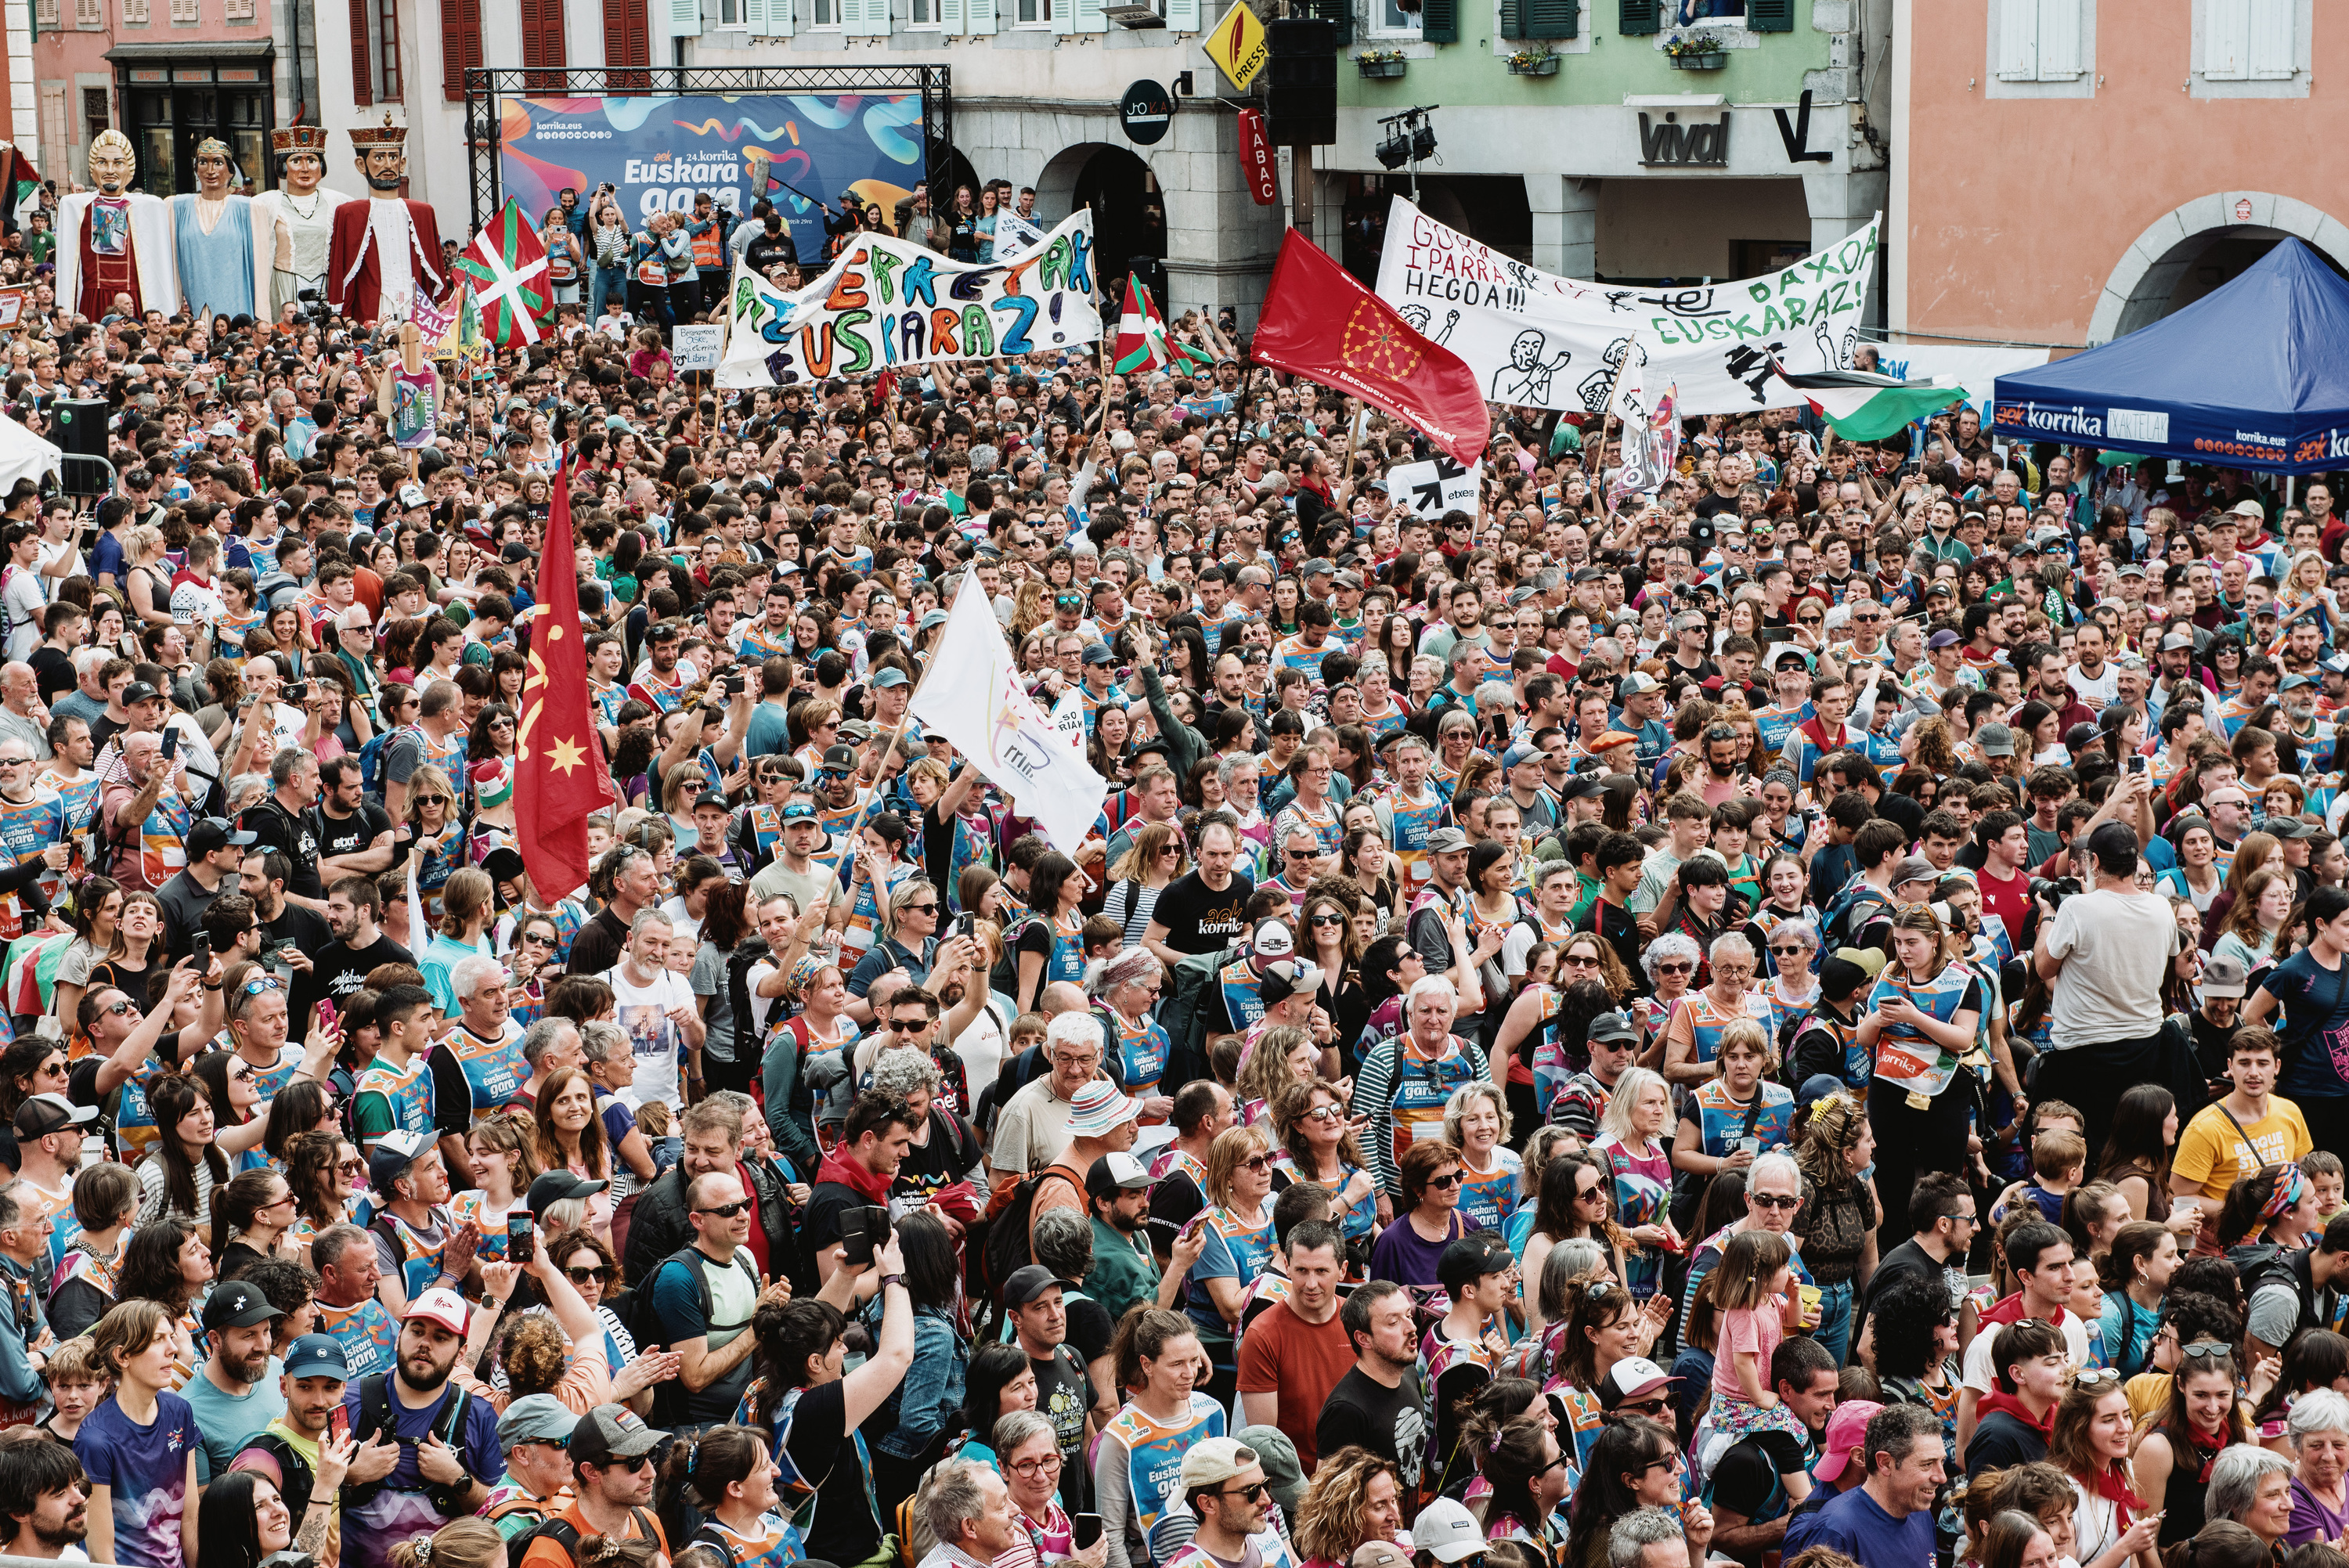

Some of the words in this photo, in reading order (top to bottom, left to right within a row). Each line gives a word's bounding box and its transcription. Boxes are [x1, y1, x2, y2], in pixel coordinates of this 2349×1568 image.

[536, 121, 583, 131] korrika.eus
[1637, 111, 1730, 163] vival
[654, 150, 672, 161] aek
[687, 149, 738, 162] 24.korrika
[1249, 115, 1273, 199] TABAC
[624, 157, 739, 184] Euskara
[1413, 215, 1496, 264] GORA
[1405, 245, 1507, 286] IPARRA
[1651, 280, 1862, 344] EUSKARAZ!
[1339, 371, 1396, 406] Recuperar
[422, 383, 434, 431] korrika
[1995, 401, 2024, 427] aek
[2026, 401, 2103, 438] korrika
[2107, 409, 2168, 442] TXARTELAK
[2235, 428, 2287, 447] korrika.eus
[2294, 432, 2329, 463] aek
[1763, 727, 1791, 737] Euskara
[2, 827, 38, 840] Euskara
[1405, 827, 1429, 835] Euskara
[9, 834, 39, 849] gara
[425, 870, 449, 884] gara
[1199, 917, 1243, 935] korrika
[1133, 1053, 1158, 1067] Euskara
[1882, 1051, 1917, 1075] korrika
[1922, 1069, 1946, 1087] aek
[482, 1071, 513, 1087] Euskara
[1138, 1062, 1160, 1078] gara
[1855, 1061, 1871, 1081] gara
[489, 1078, 516, 1100] gara
[2234, 1131, 2286, 1154] BASQUE
[2238, 1147, 2286, 1170] STREET
[1467, 1206, 1498, 1217] Euskara
[1149, 1217, 1182, 1231] ERRENTERIA
[346, 1346, 378, 1377] gara
[1199, 1398, 1217, 1408] eitb
[1153, 1457, 1182, 1472] 24.korrika
[1265, 1538, 1280, 1552] eitb
